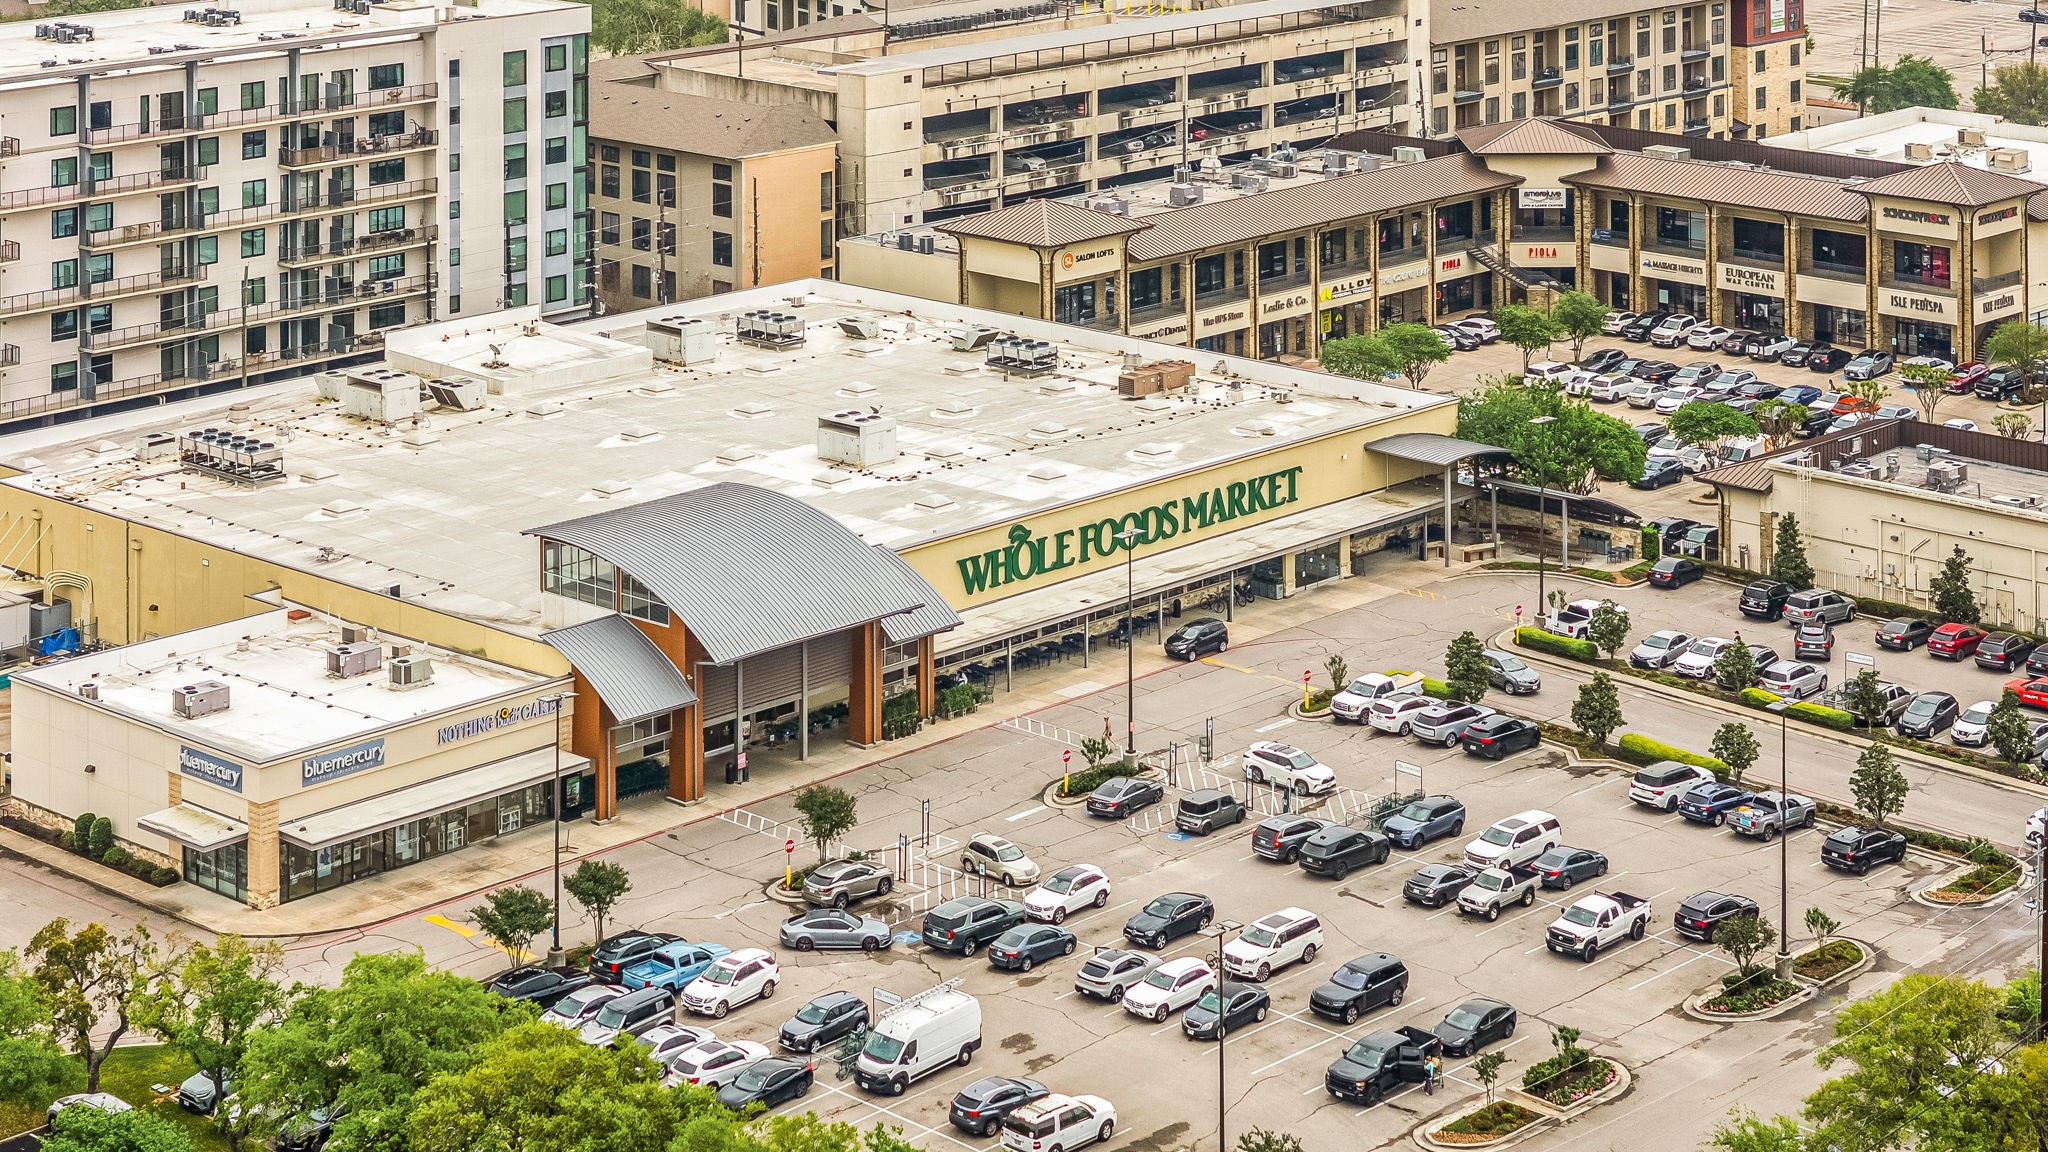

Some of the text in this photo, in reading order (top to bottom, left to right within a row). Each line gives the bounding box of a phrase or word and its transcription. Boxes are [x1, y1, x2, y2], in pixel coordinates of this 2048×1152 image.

[1075, 248, 1114, 263] SALON LOFTS
[1529, 247, 1557, 257] PIOLA
[1442, 257, 1461, 270] PIOLA
[1652, 260, 1703, 275] MASSAGE HEIGHTS
[1725, 267, 1775, 283] EUROPEAN
[1332, 277, 1372, 293] ALLOY
[1725, 277, 1775, 290] WAX CENTER
[1286, 297, 1294, 309] &
[1890, 295, 1908, 309] ISLE
[957, 466, 1304, 596] WHOLE FOODS MARKET
[438, 714, 495, 746] NOTHING
[180, 749, 240, 787] bluemercury
[303, 744, 385, 778] bluemercury
